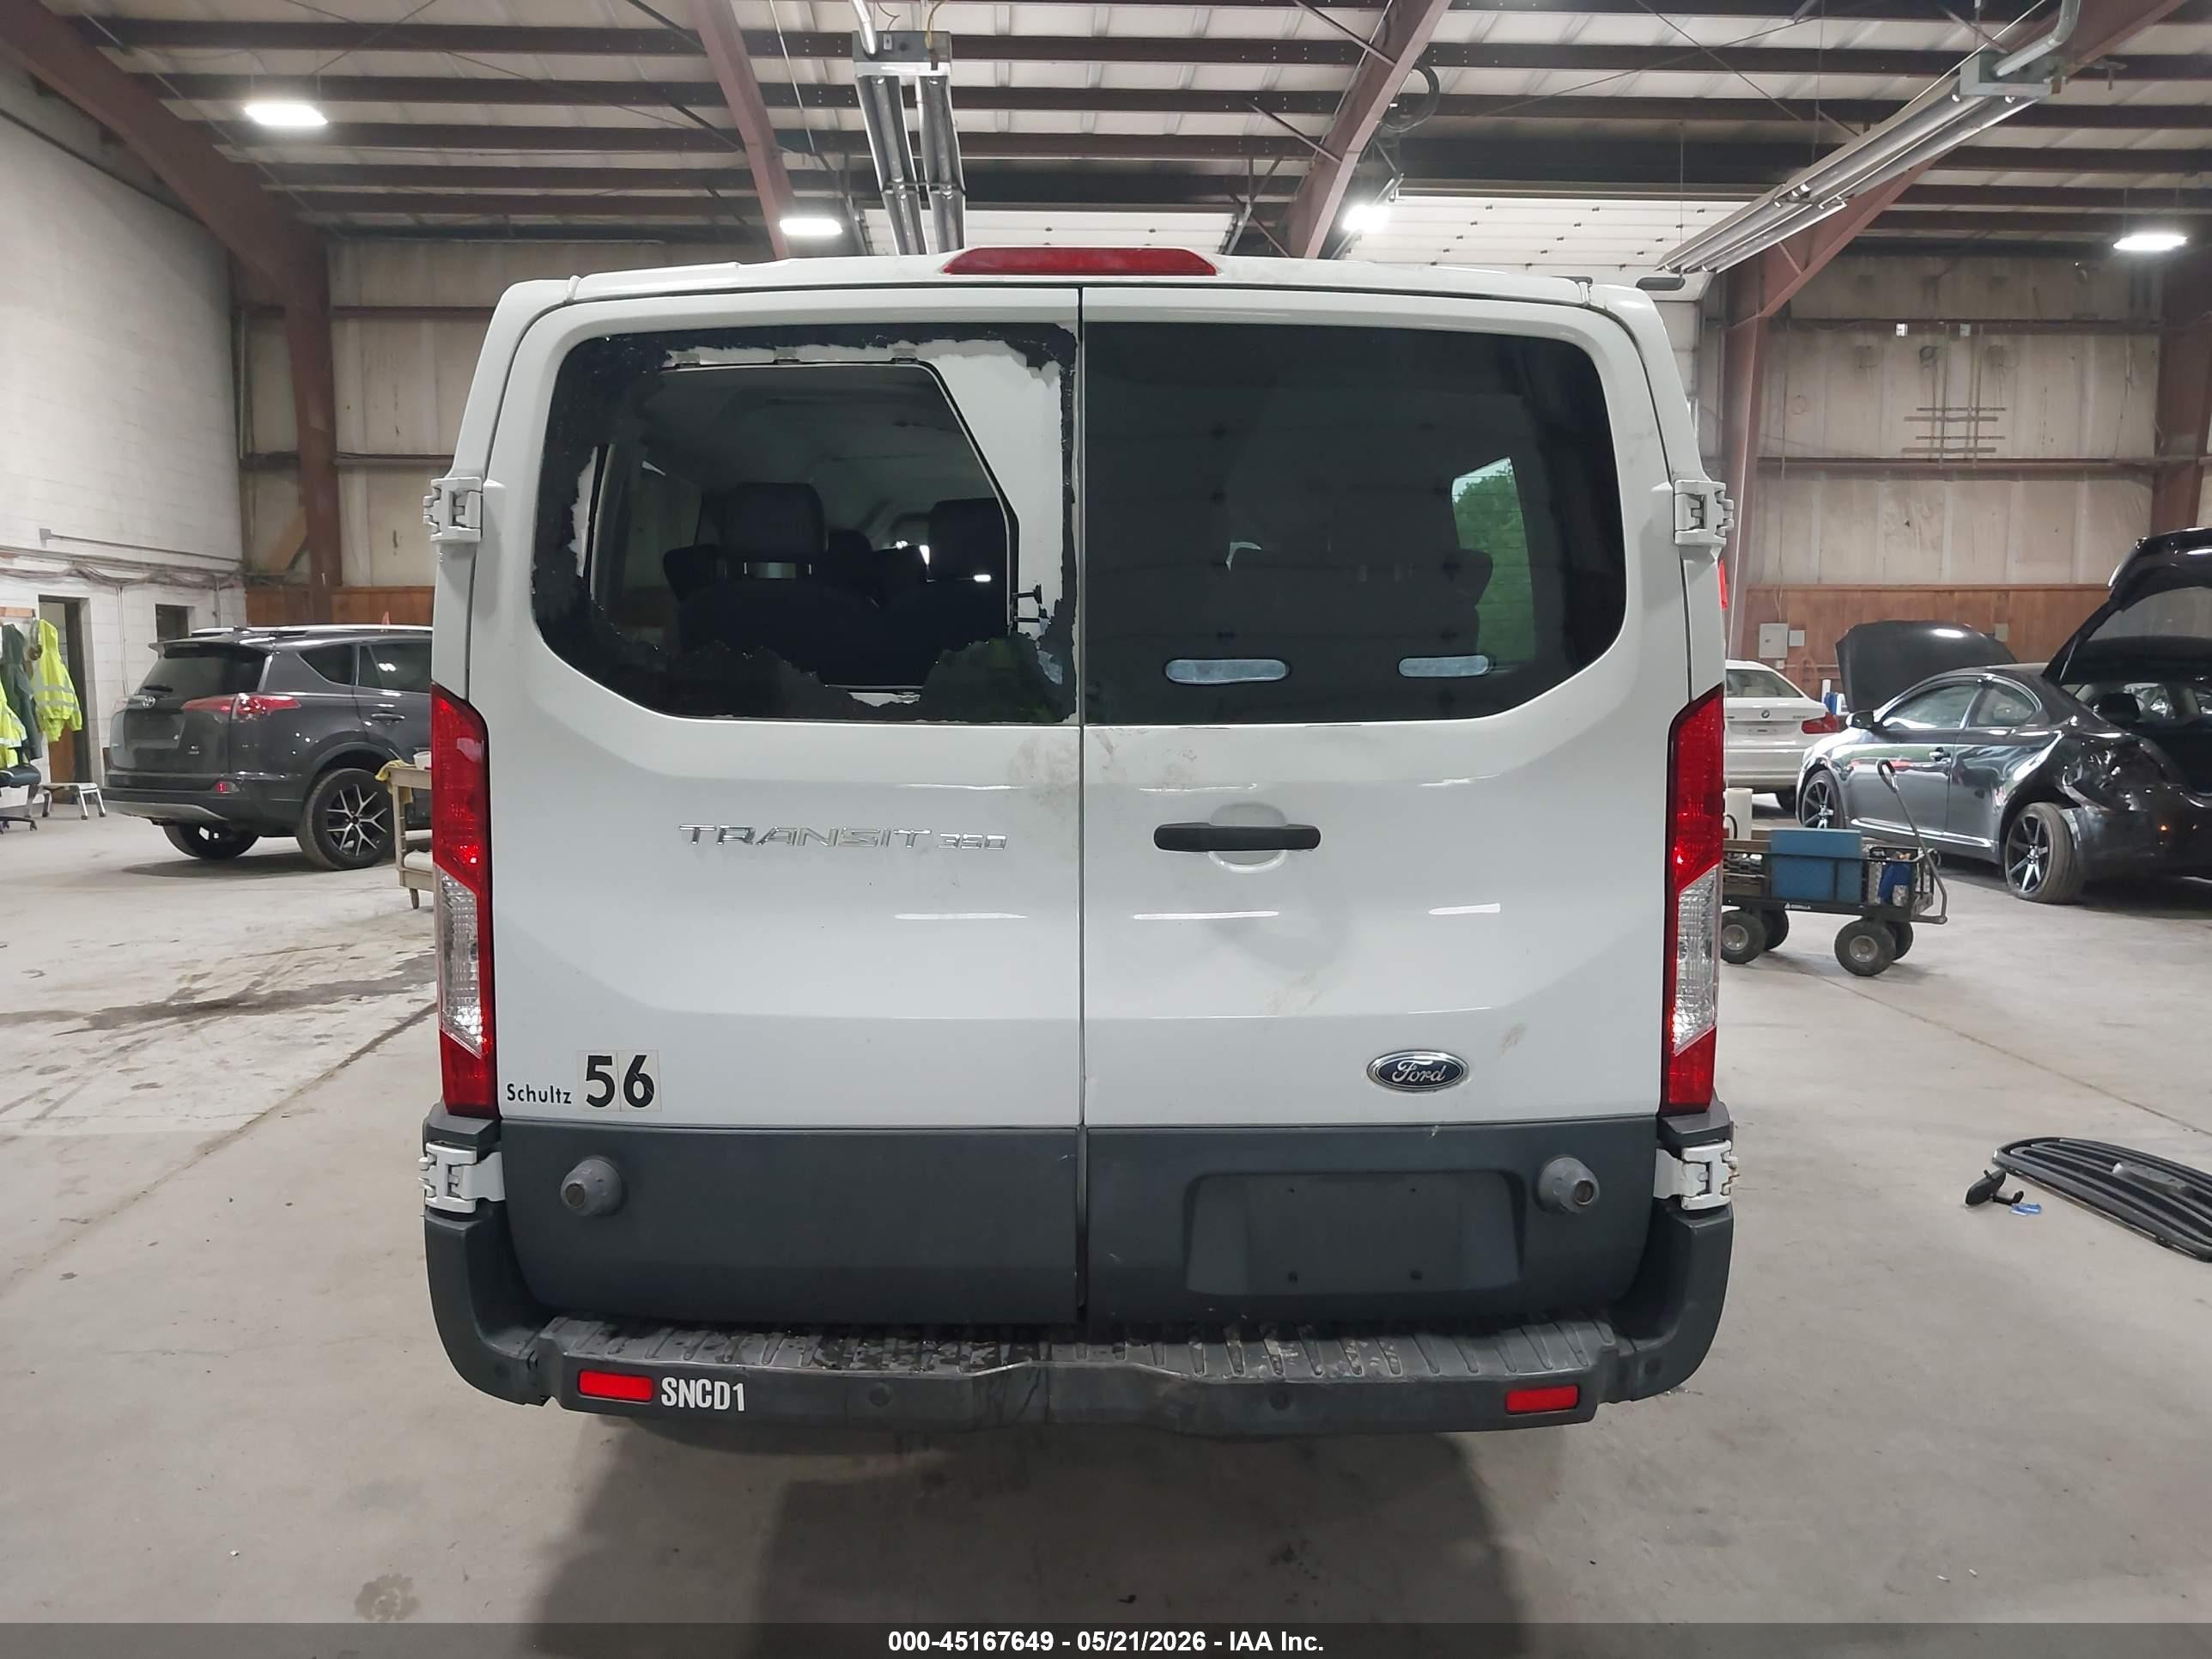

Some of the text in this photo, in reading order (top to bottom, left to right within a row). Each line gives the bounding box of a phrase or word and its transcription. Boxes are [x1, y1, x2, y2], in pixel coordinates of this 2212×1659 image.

[678, 823, 1008, 851] TRANSIT 350
[586, 1054, 655, 1108] 56
[1391, 1060, 1447, 1082] Ford
[507, 1083, 572, 1104] Schultz
[661, 1376, 745, 1412] SNCD1
